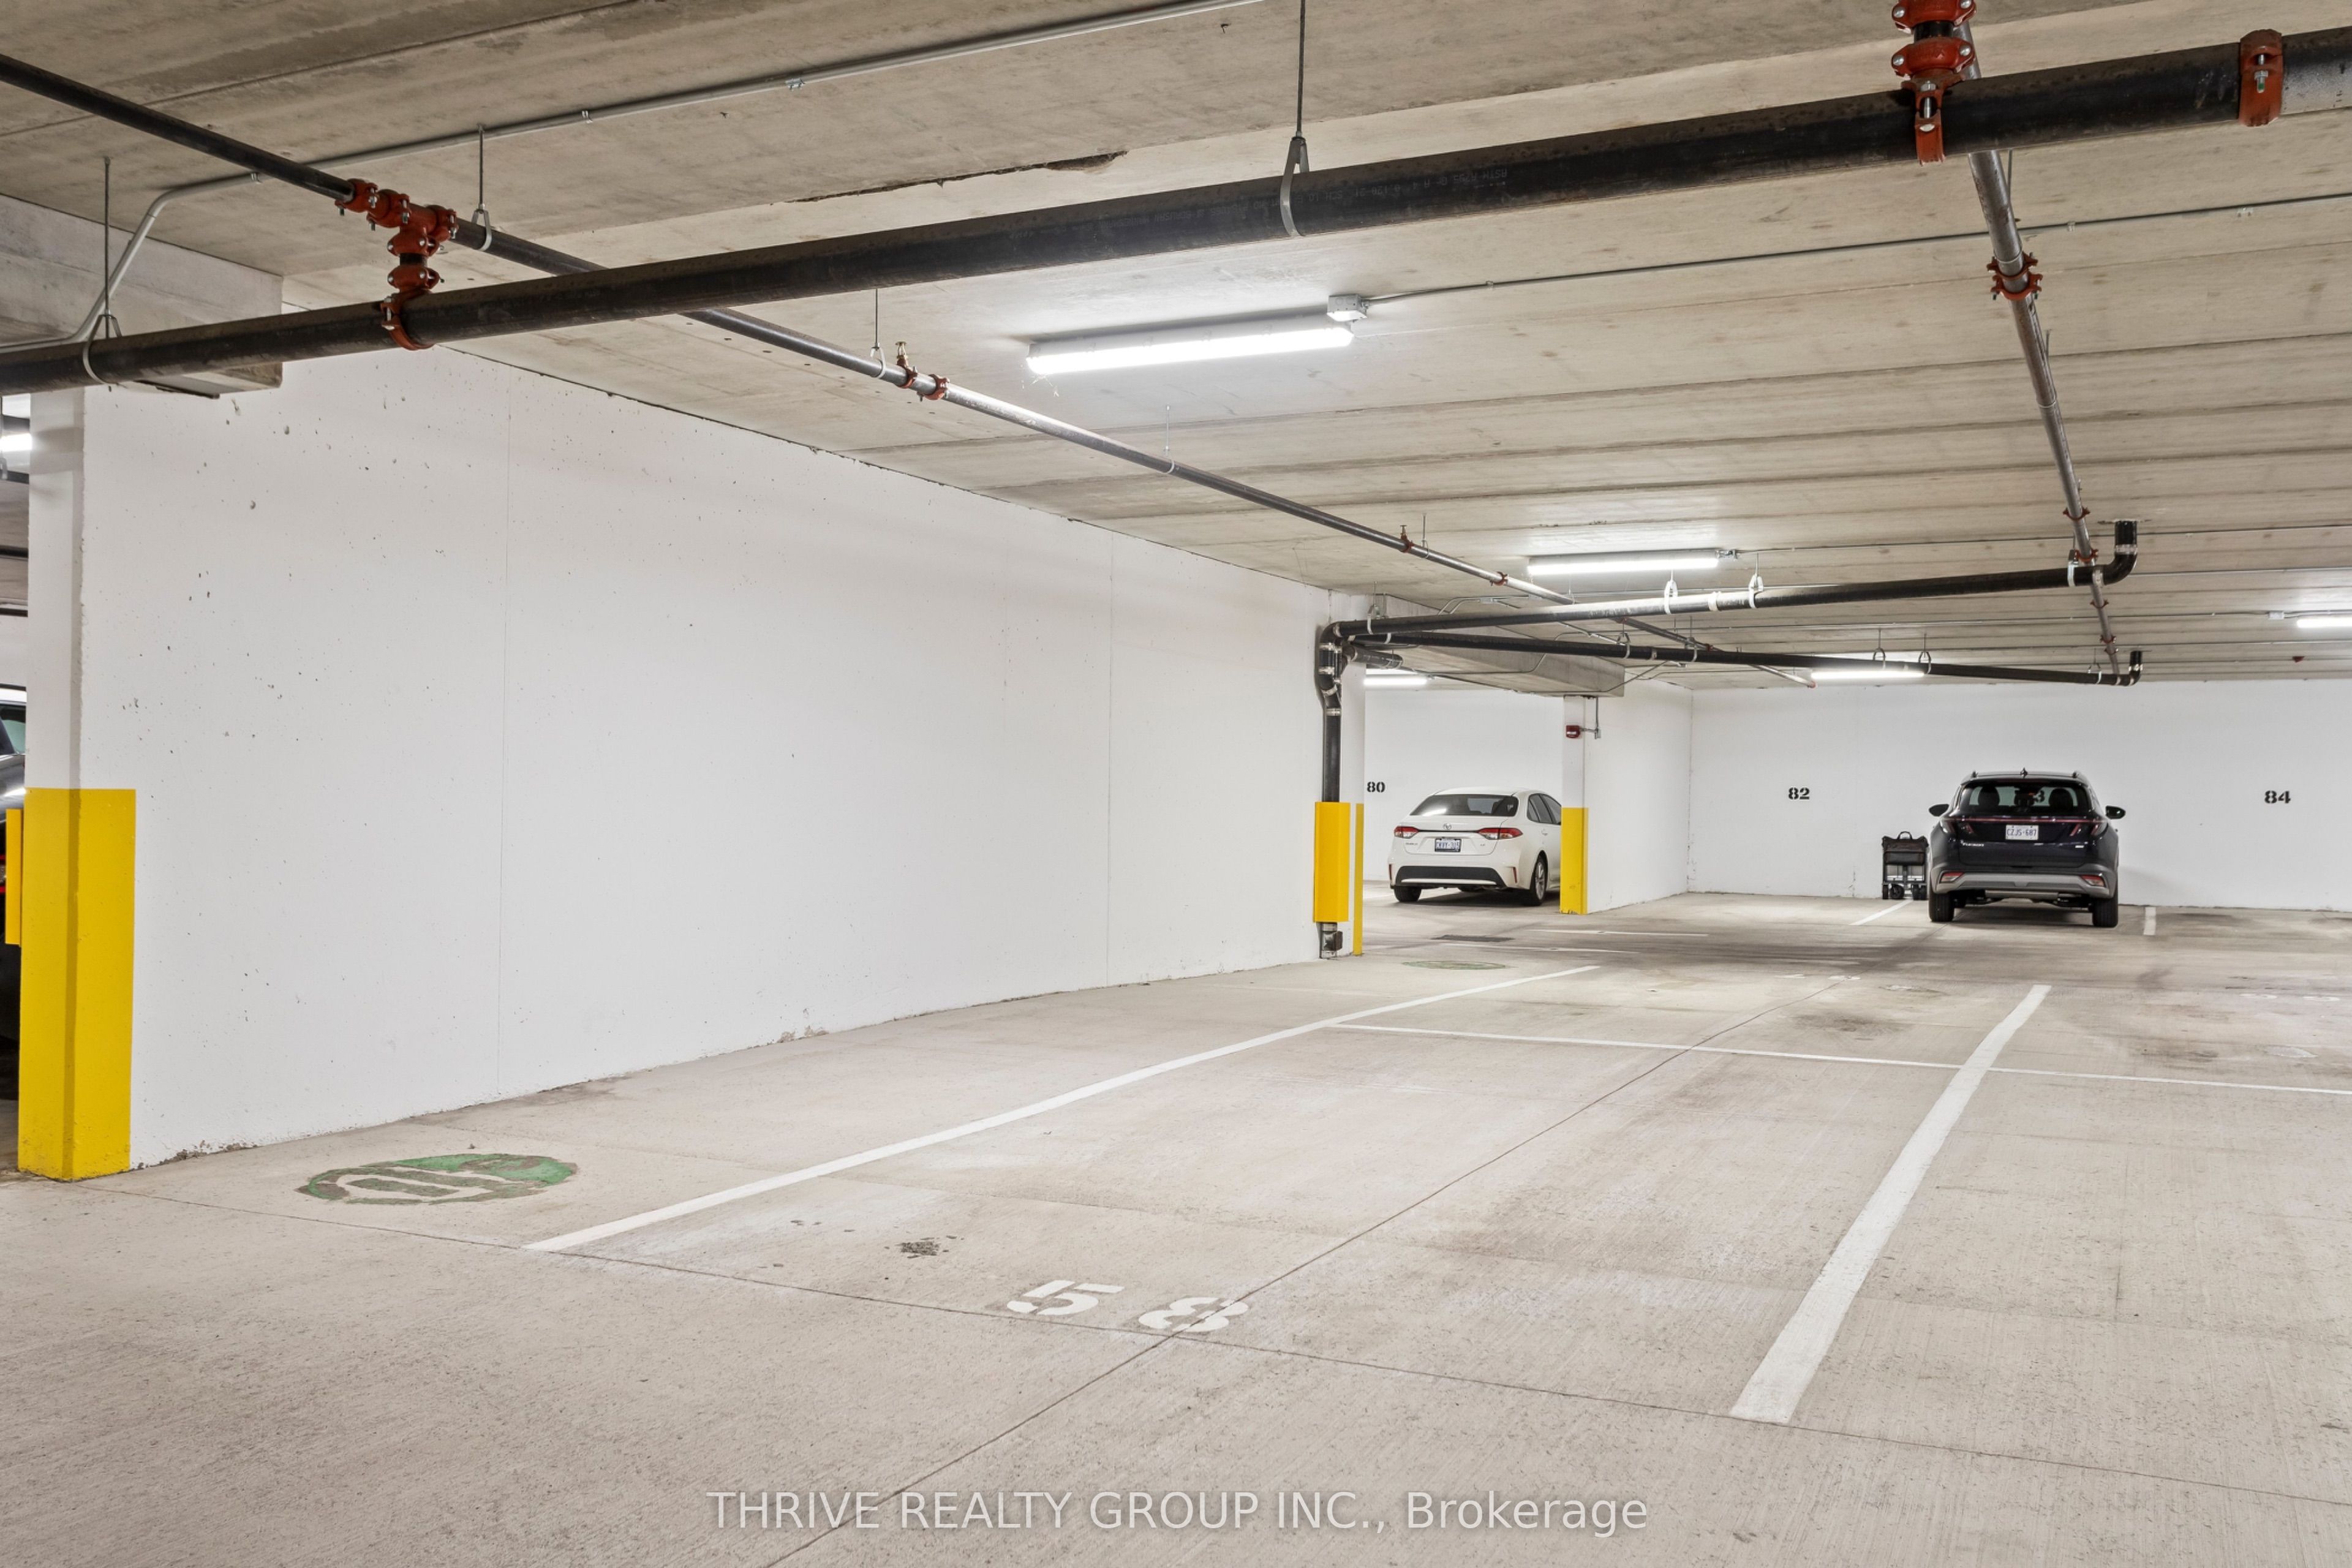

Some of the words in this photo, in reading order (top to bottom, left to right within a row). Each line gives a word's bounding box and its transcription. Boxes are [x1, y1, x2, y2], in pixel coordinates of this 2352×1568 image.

[1367, 781, 1385, 793] 80
[1789, 787, 1810, 800] 82
[2264, 790, 2291, 804] 84
[1006, 1280, 1248, 1332] 58
